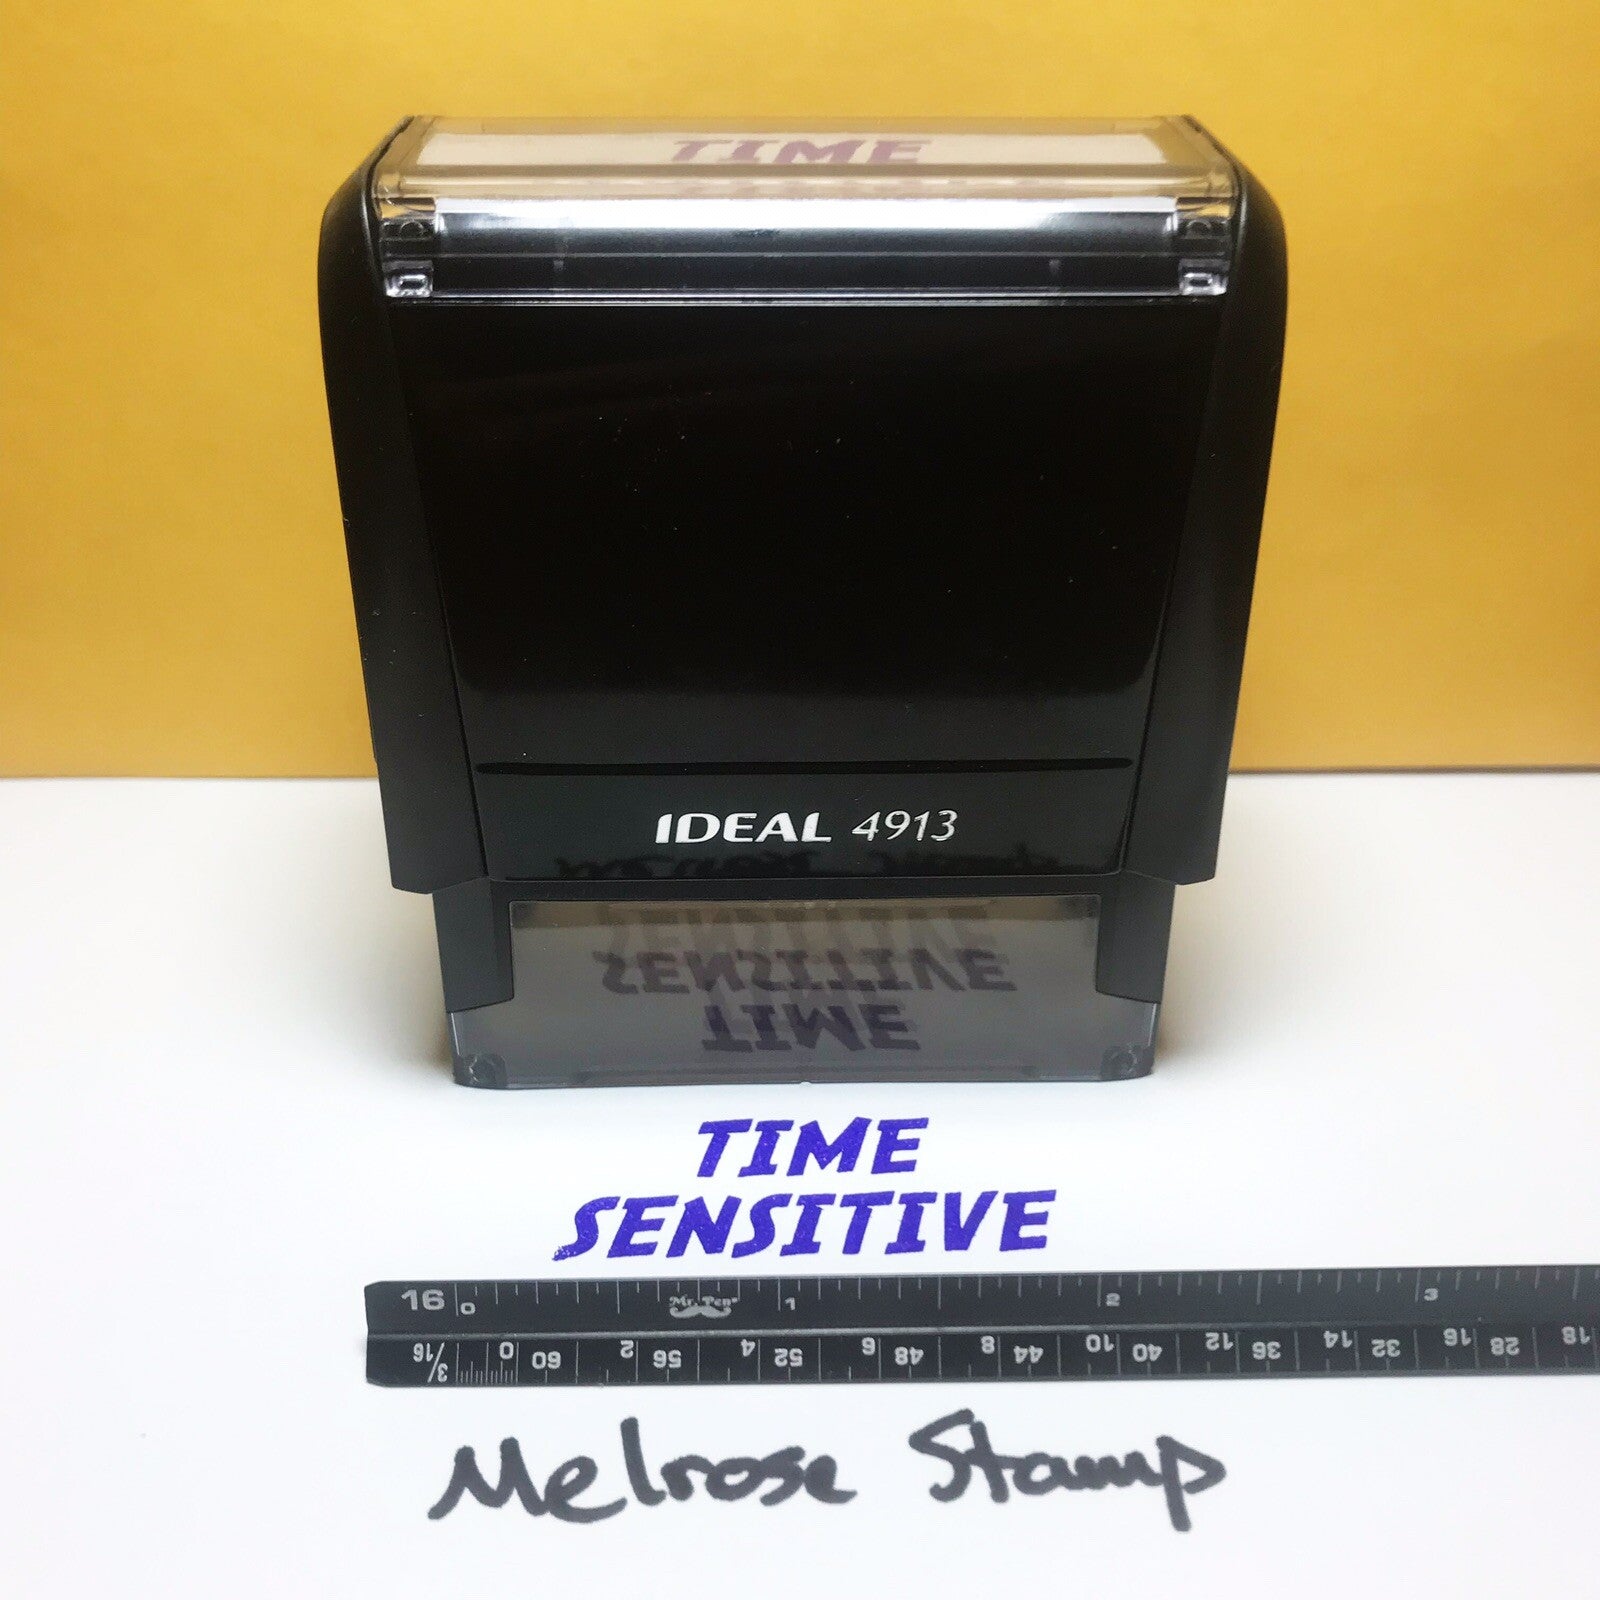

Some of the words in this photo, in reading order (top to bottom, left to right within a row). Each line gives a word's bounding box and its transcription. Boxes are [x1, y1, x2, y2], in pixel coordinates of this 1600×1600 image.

[671, 138, 932, 165] TIME
[655, 812, 832, 844] IDEAL
[851, 809, 958, 842] 4913
[698, 1116, 929, 1177] TIME
[554, 1190, 1056, 1261] SENSITIVE
[400, 1288, 445, 1311] 16
[784, 1297, 796, 1311] 1
[1106, 1292, 1121, 1307] 2
[1424, 1287, 1438, 1302] 3
[980, 1335, 996, 1355] 8
[1085, 1333, 1115, 1353] 10
[1205, 1331, 1234, 1351] 12
[1323, 1329, 1353, 1349] 14
[1443, 1327, 1472, 1347] 16
[1561, 1325, 1590, 1345] 18
[499, 1341, 515, 1360] 0
[620, 1339, 635, 1359] 2
[740, 1338, 756, 1357] 4
[861, 1336, 876, 1356] 6
[894, 1346, 925, 1366] 48
[1013, 1345, 1044, 1364] 44
[1132, 1343, 1163, 1363] 40
[1251, 1341, 1282, 1360] 36
[1371, 1338, 1401, 1358] 32
[1489, 1336, 1520, 1356] 28
[531, 1351, 562, 1370] 60
[652, 1350, 682, 1369] 56
[774, 1348, 803, 1367] 52
[427, 1417, 856, 1524] Melrose
[908, 1408, 1226, 1532] Stamp
